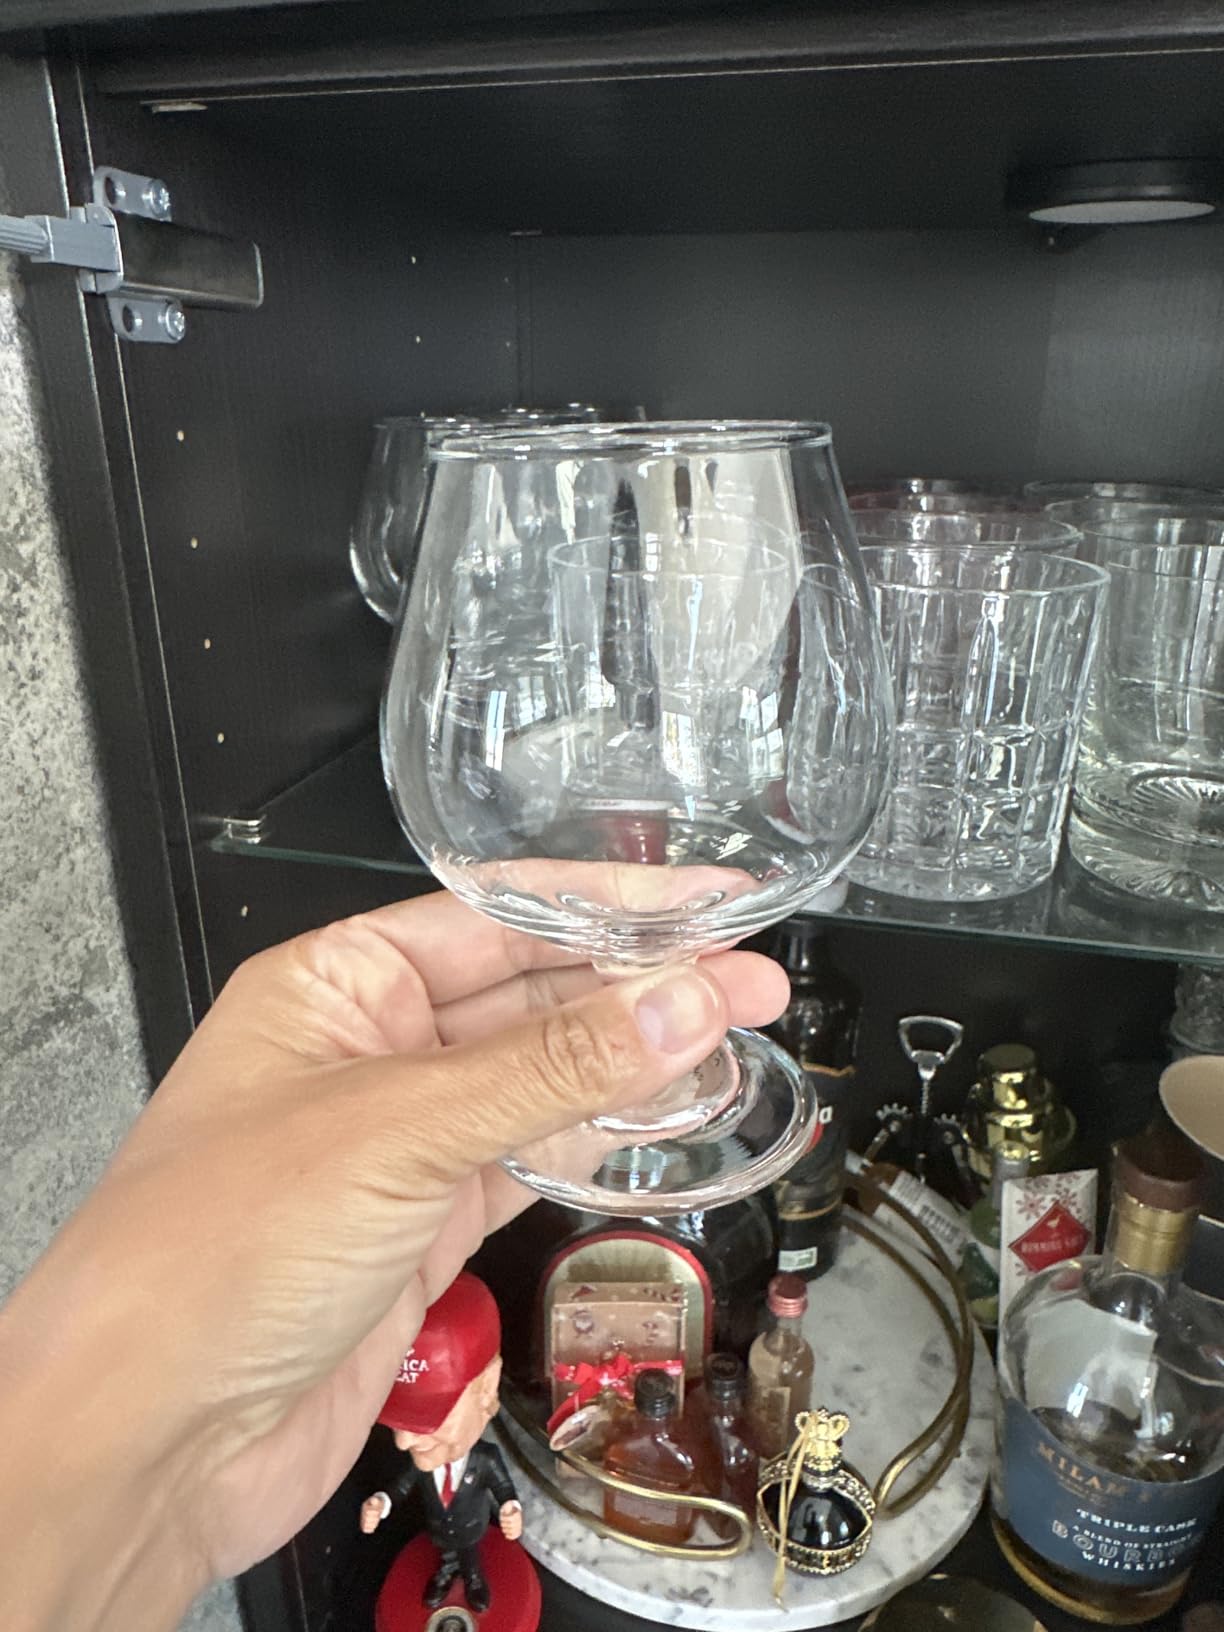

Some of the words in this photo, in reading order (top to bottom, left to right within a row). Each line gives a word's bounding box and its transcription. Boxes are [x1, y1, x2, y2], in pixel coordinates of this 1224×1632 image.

[400, 1359, 430, 1372] ICA
[1076, 1508, 1150, 1533] TRIPLE
[1083, 1529, 1121, 1546] BLEND
[1124, 1541, 1140, 1549] OF
